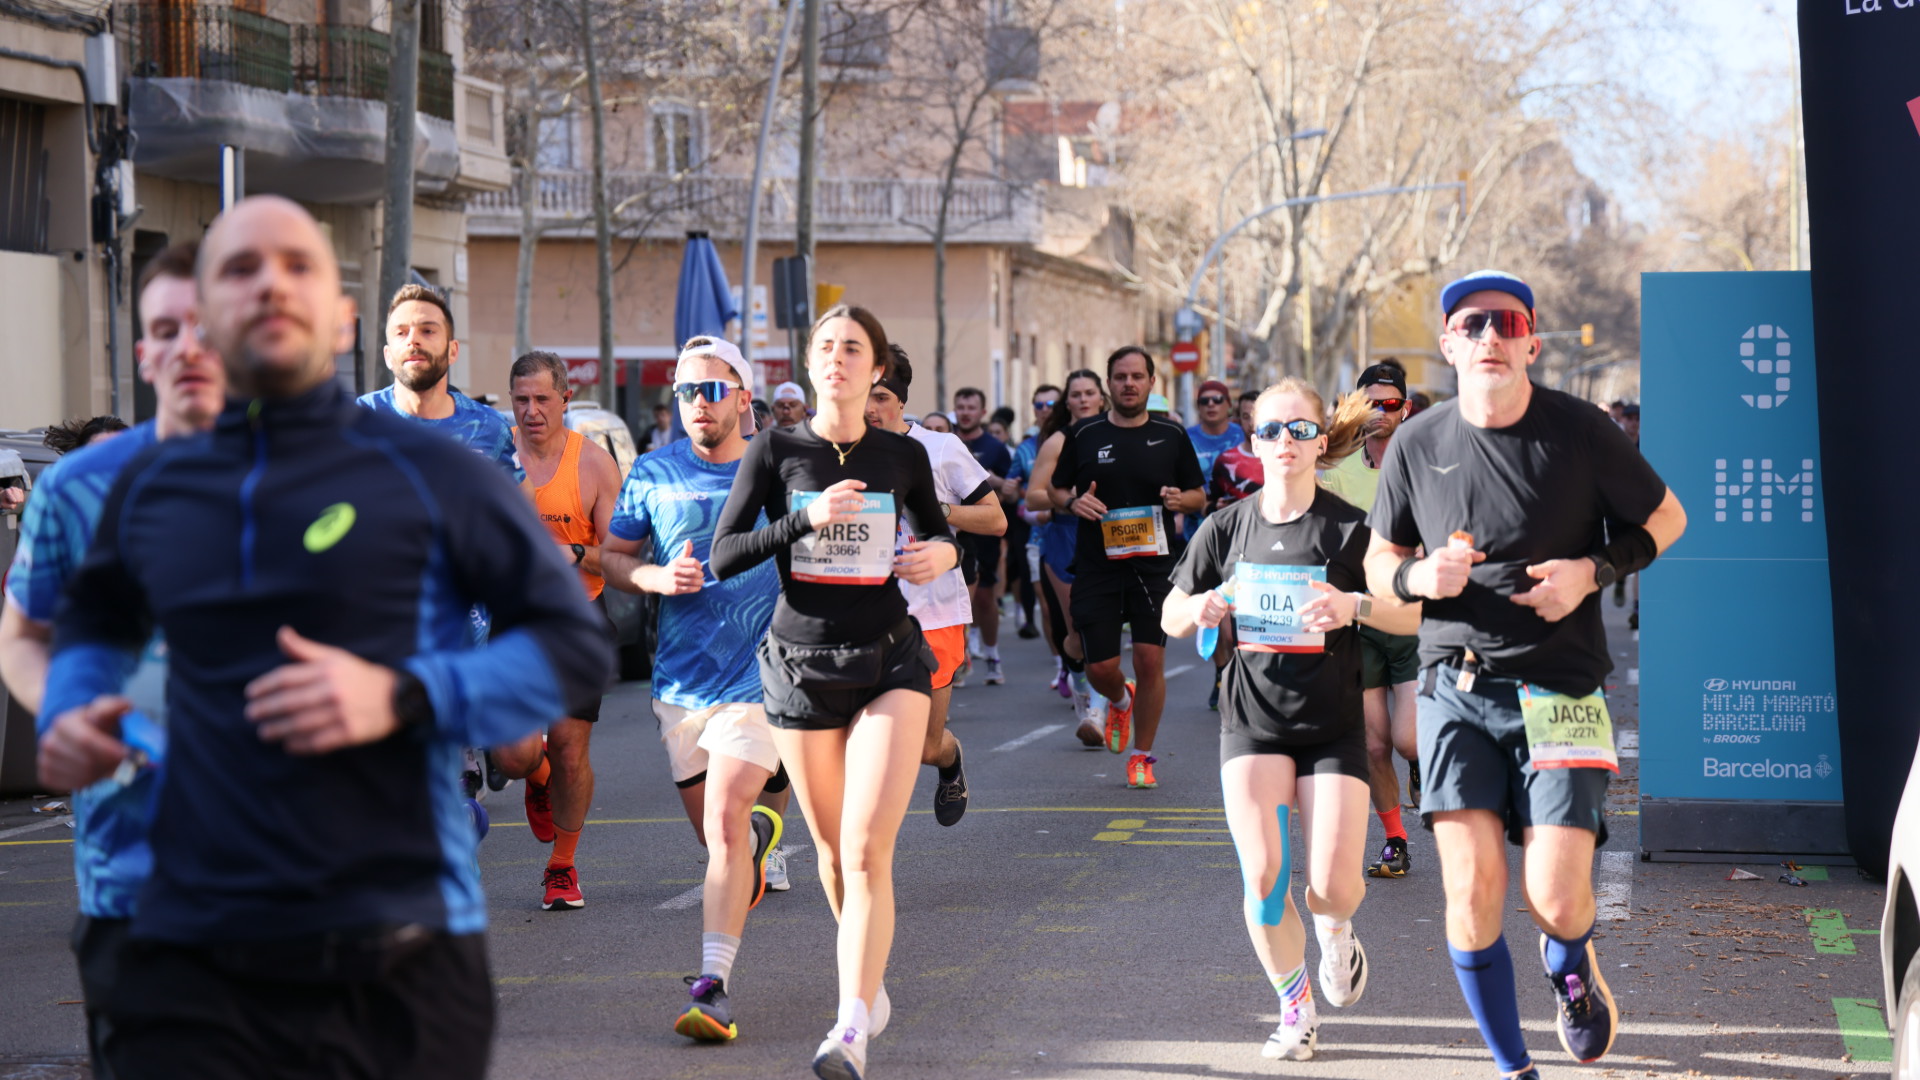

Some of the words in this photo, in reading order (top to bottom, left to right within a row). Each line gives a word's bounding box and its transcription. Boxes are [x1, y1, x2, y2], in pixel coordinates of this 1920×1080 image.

[1740, 324, 1791, 409] 9
[1098, 450, 1110, 459] EY
[1715, 459, 1813, 522] KM
[540, 514, 563, 523] CIRSA
[818, 523, 870, 542] ARES
[1111, 523, 1147, 536] PSORRI
[825, 543, 861, 556] 33664
[823, 565, 862, 575] BROOKS
[1264, 570, 1313, 581] HYUNDAI
[1260, 593, 1294, 612] OLA
[1260, 614, 1293, 627] 34239
[1259, 634, 1293, 643] BROOKS
[1731, 680, 1797, 691] HYUNDAI
[1703, 693, 1755, 712] MITJA
[1763, 692, 1836, 713] MARATÓ
[1549, 704, 1604, 726] JACEK
[1703, 713, 1806, 732] BARCELONA
[1713, 734, 1762, 744] BROOKS
[1703, 757, 1812, 779] Barcelona
